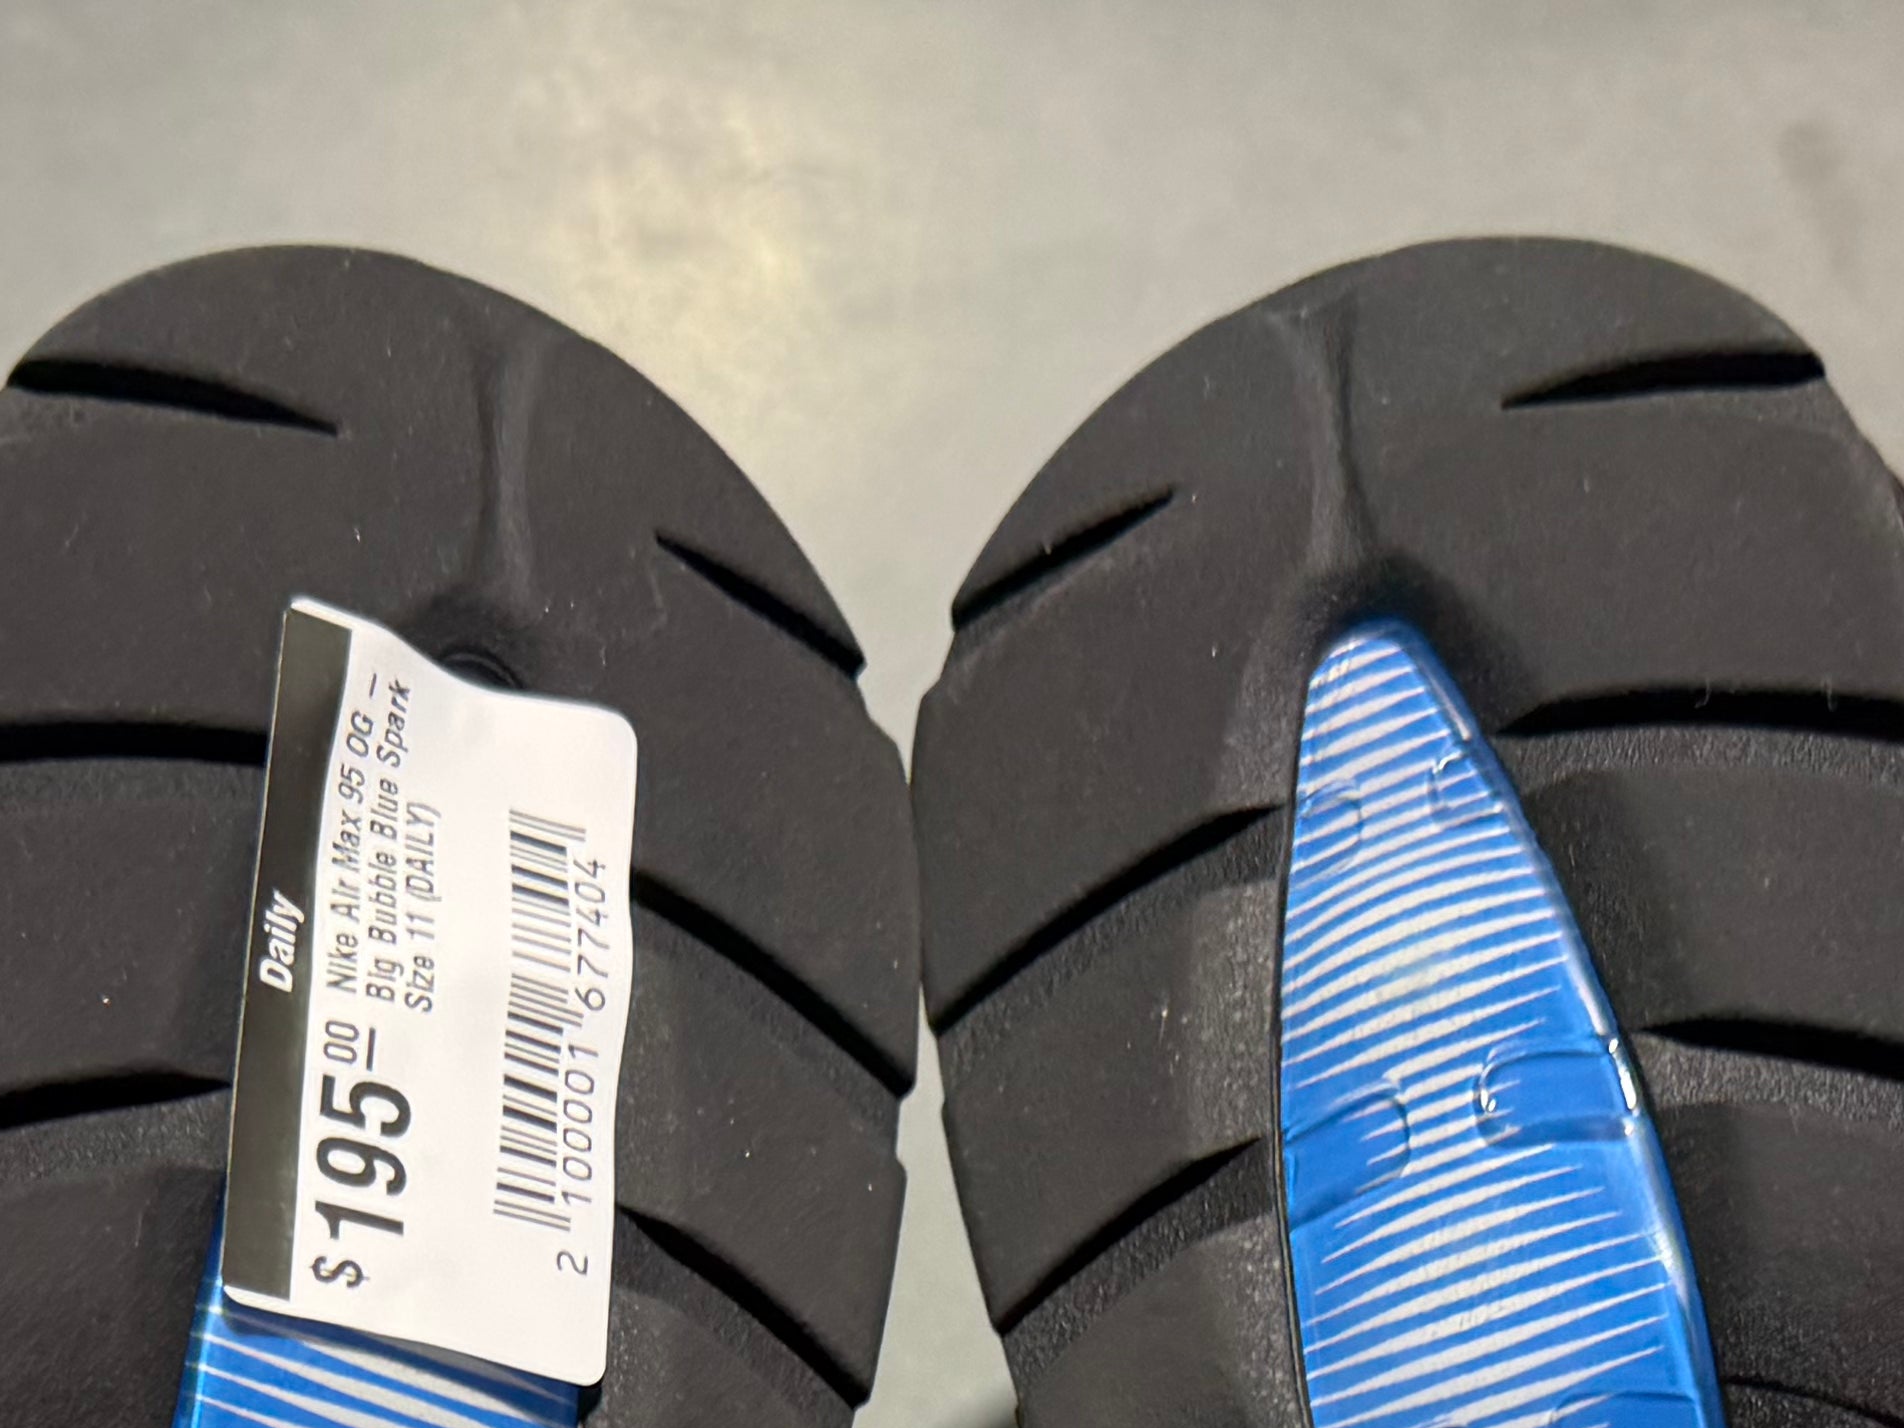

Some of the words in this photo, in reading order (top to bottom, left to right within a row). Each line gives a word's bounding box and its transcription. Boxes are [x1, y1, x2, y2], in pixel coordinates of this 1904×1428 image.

[346, 710, 374, 757] OG
[376, 679, 410, 768] Spark
[338, 763, 365, 804] 95
[369, 778, 398, 840] Blue
[332, 808, 363, 873] Max
[404, 802, 442, 902] (DAILY)
[330, 878, 360, 924] Air
[367, 851, 398, 945] Bubble
[406, 911, 435, 940] 11
[259, 887, 305, 993] Daily
[326, 933, 359, 994] Nike
[573, 859, 610, 1012] 677404
[365, 955, 404, 1002] Big
[404, 955, 435, 1013] Size
